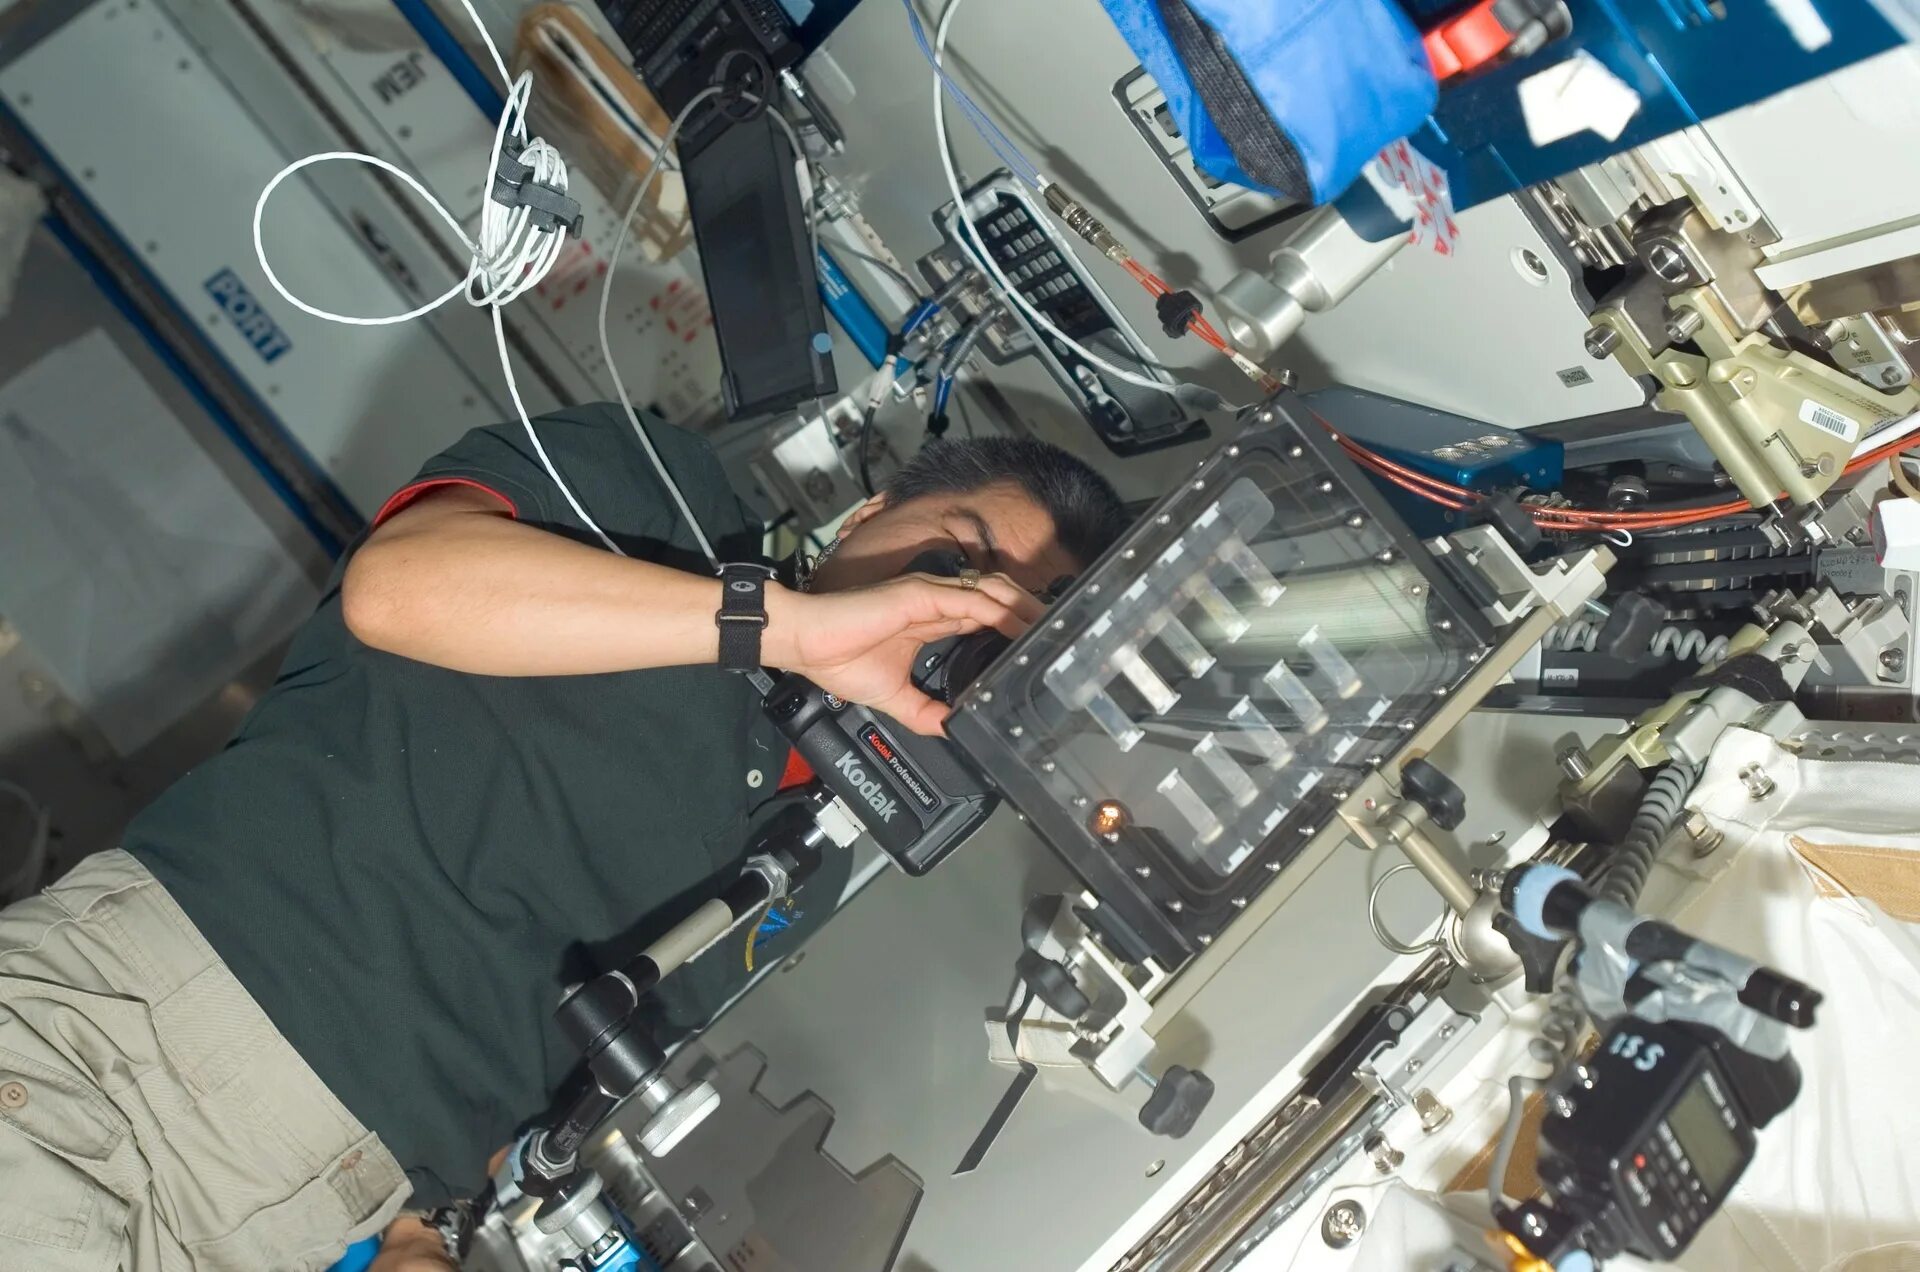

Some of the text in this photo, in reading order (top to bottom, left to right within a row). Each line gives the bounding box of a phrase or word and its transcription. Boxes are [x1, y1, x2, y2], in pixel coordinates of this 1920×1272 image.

[371, 52, 426, 104] JEM
[207, 271, 289, 358] PORT
[834, 750, 899, 823] Kodak
[869, 732, 934, 806] Kodak Professional
[1609, 1032, 1665, 1071] ISS
